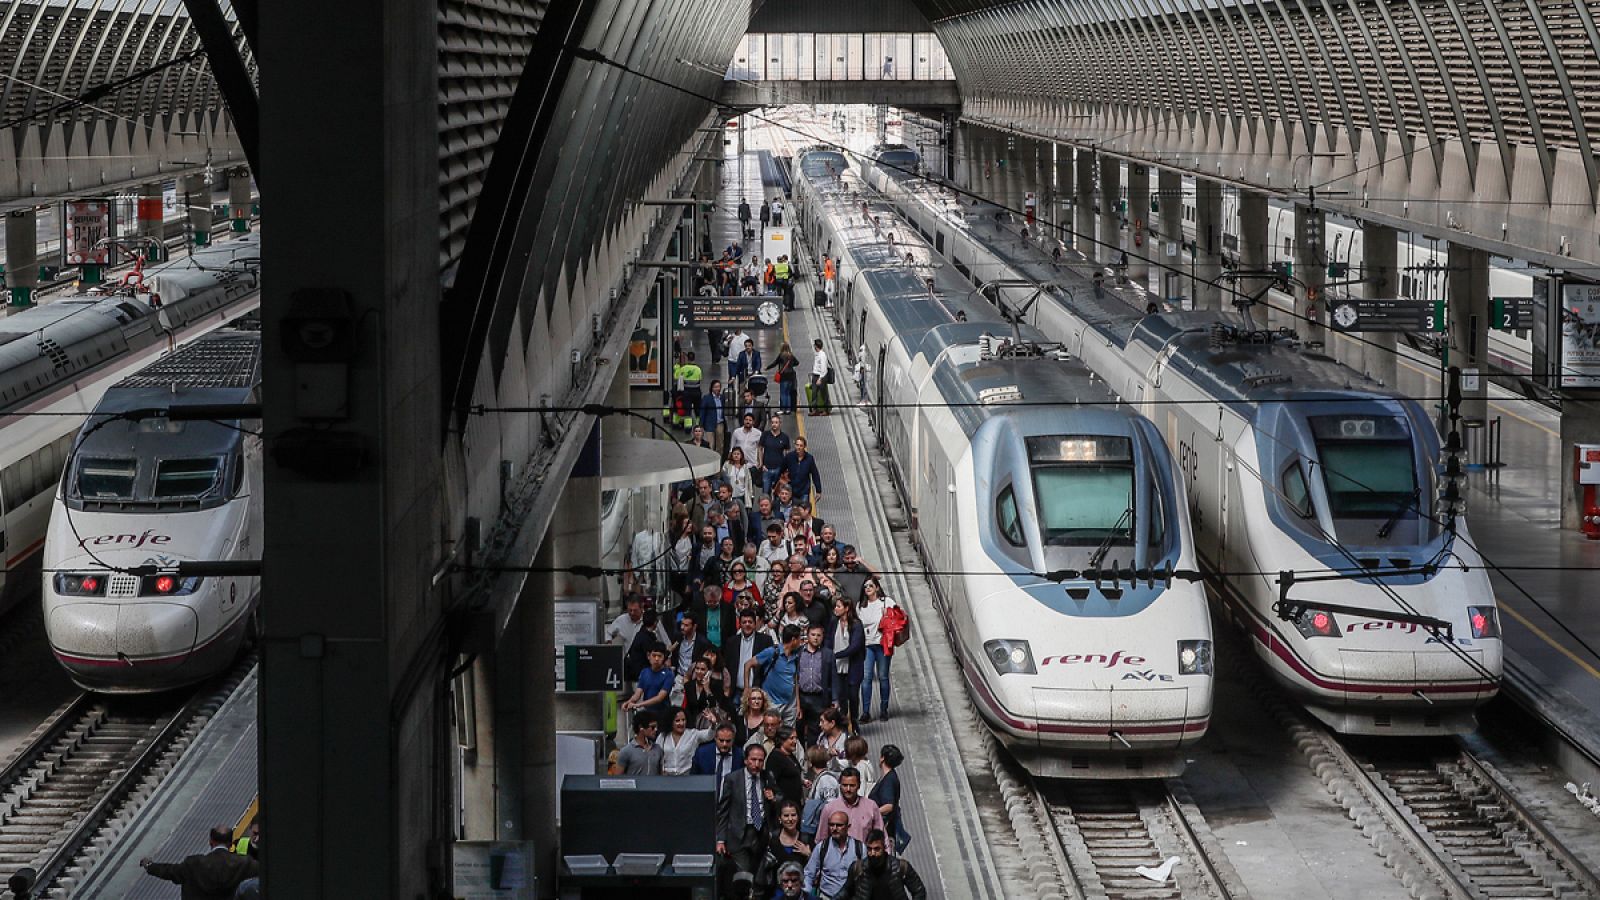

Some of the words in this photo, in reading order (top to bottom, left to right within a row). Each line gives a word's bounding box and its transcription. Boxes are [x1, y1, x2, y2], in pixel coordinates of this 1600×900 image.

[678, 313, 689, 327] 4
[1426, 315, 1435, 329] 3
[1503, 314, 1511, 328] 2
[78, 528, 172, 549] renfe
[1041, 650, 1146, 669] renfe
[606, 668, 620, 688] 4
[1120, 668, 1174, 682] AVE
